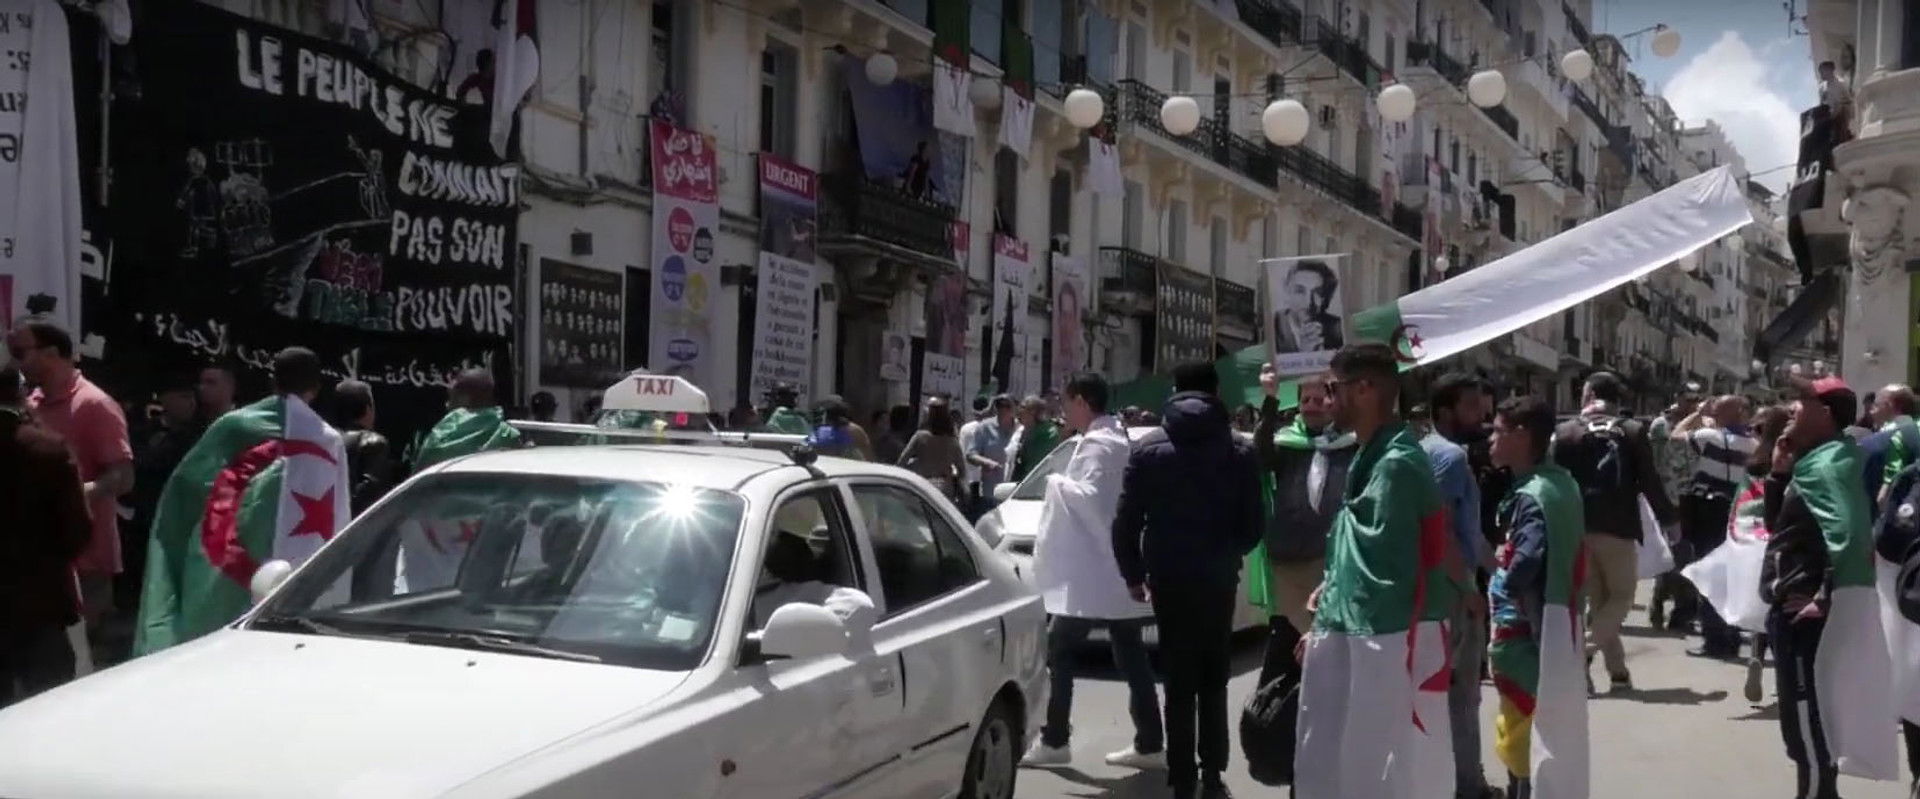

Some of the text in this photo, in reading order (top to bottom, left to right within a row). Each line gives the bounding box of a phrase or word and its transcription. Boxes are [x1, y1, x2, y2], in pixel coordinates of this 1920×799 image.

[236, 28, 460, 149] LE PEUPLE NE
[397, 149, 518, 208] CONNAIT
[765, 161, 809, 194] URGENT
[389, 209, 506, 270] PAS SON
[395, 283, 514, 337] POUVOIR
[633, 377, 675, 396] TAXI
